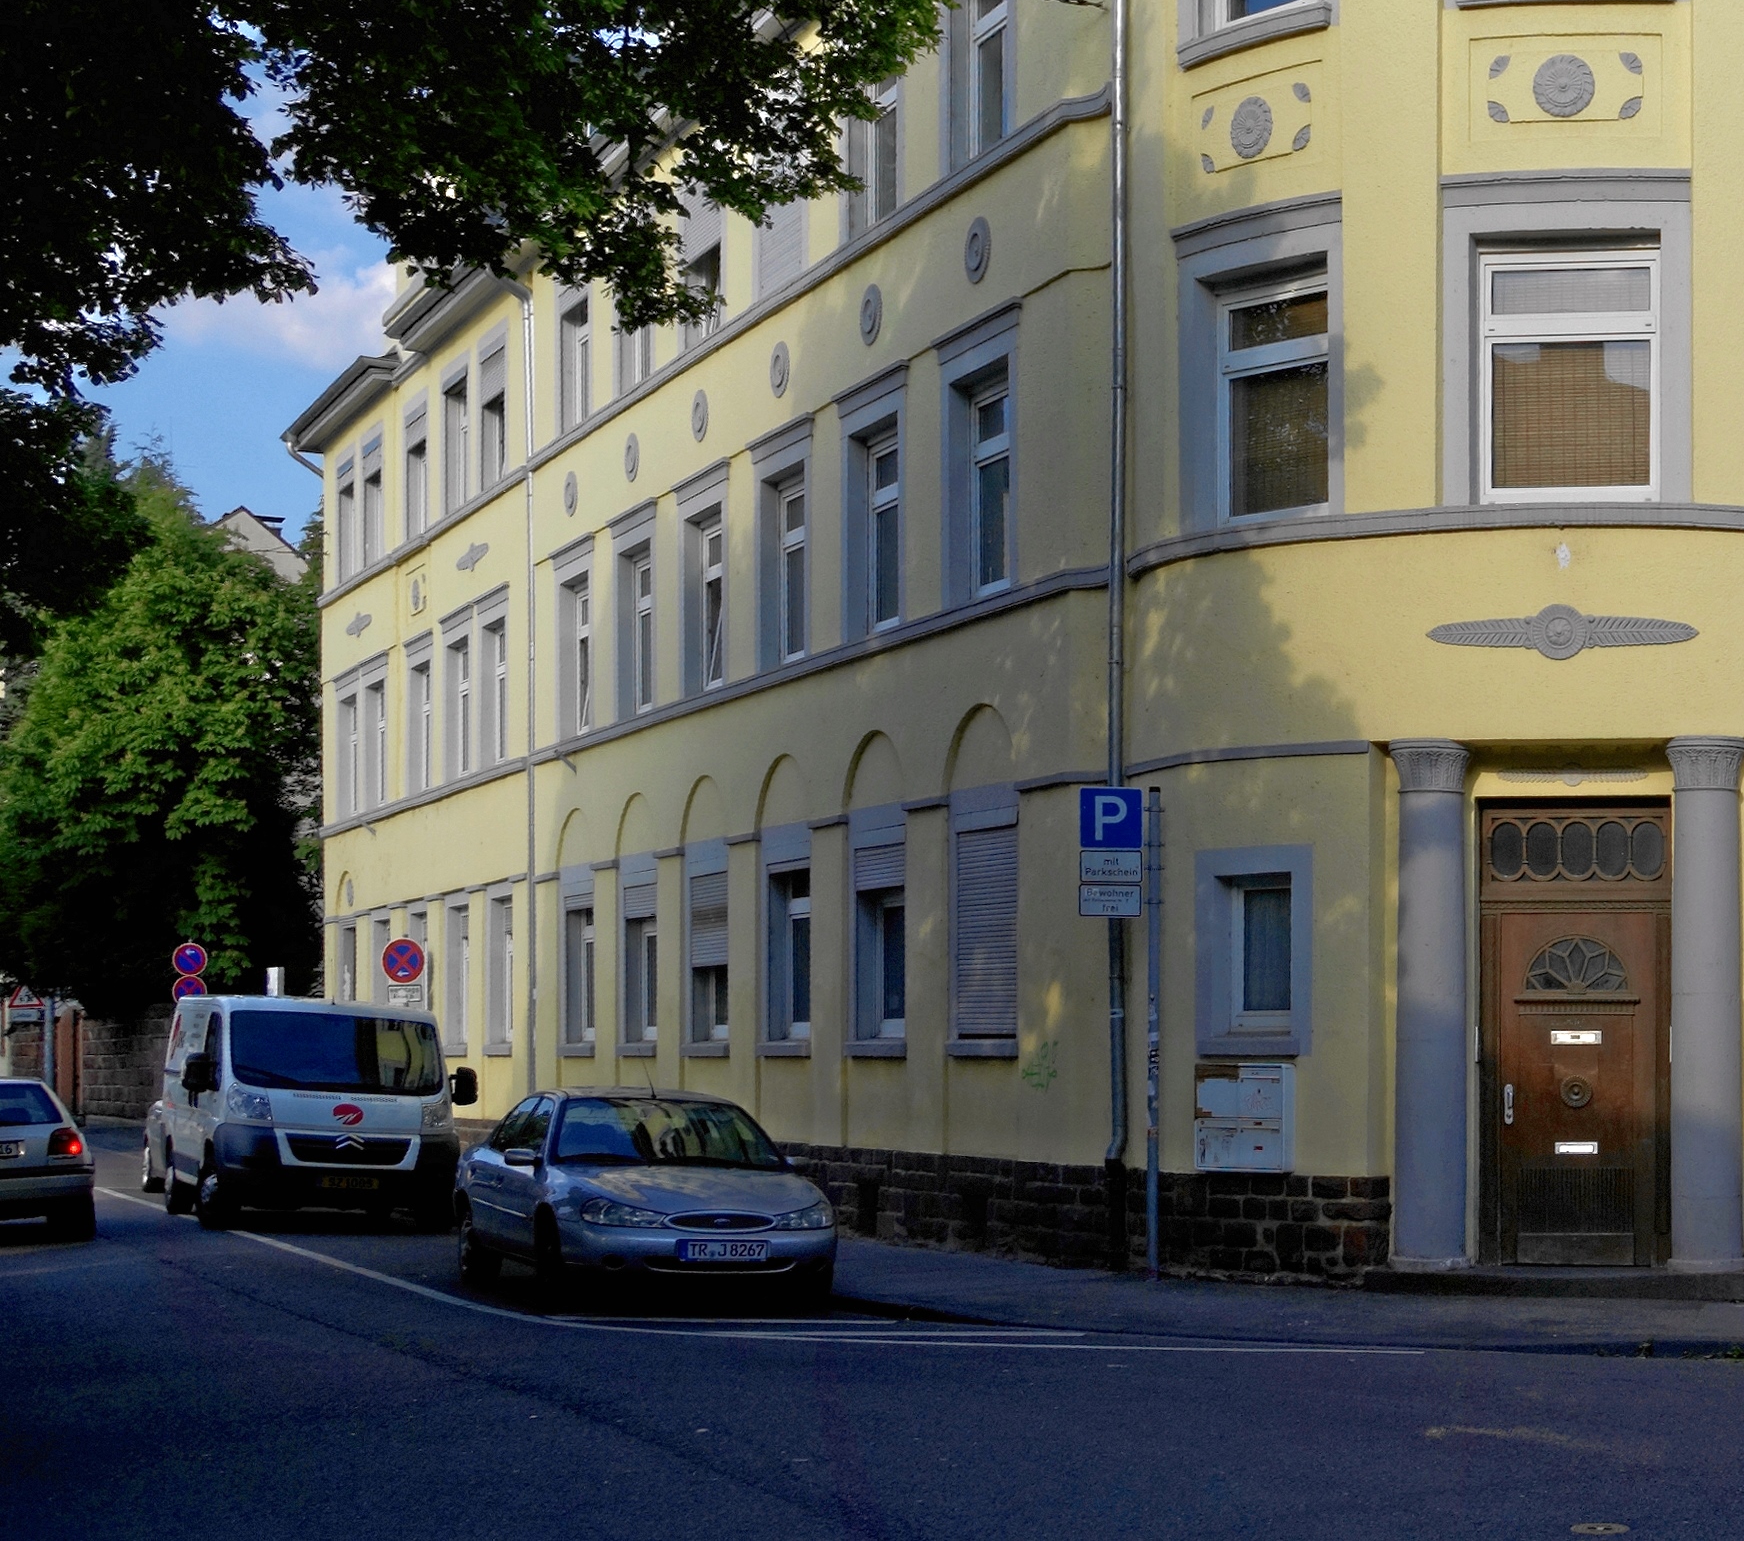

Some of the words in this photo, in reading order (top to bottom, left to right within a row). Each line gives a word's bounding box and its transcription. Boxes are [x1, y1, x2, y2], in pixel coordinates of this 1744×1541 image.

[1094, 795, 1128, 841] P
[1103, 857, 1120, 866] mit
[1085, 867, 1139, 877] Parkschein
[1086, 888, 1135, 898] Bewohner
[1102, 903, 1119, 912] frei
[0, 1144, 13, 1155] 6
[690, 1243, 708, 1257] TR
[730, 1243, 765, 1257] 8267
